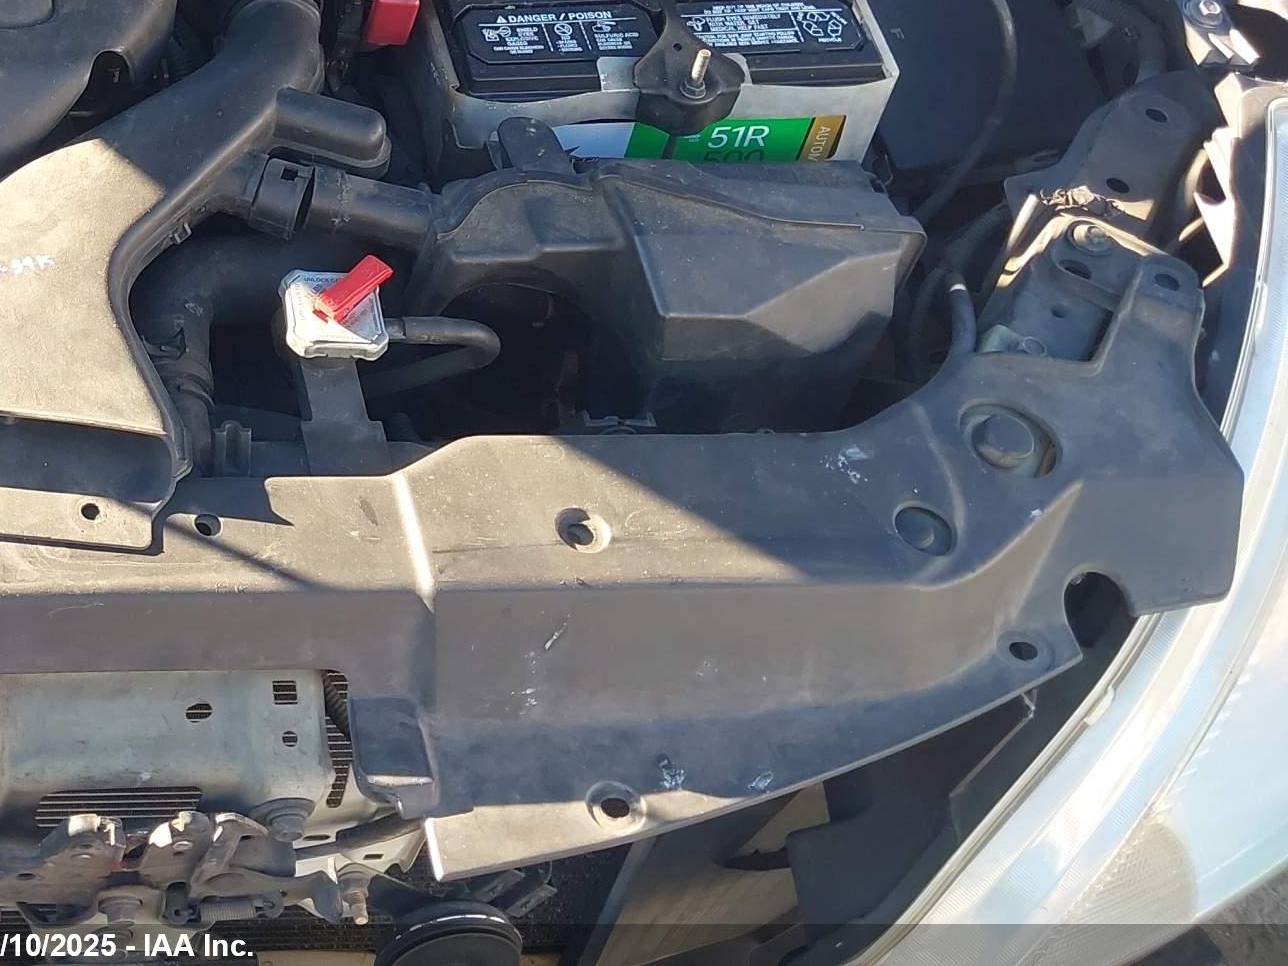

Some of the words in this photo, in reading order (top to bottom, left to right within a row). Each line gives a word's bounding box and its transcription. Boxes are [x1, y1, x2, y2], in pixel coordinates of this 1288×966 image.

[508, 13, 558, 23] DANGER
[568, 11, 613, 20] POISON
[708, 125, 770, 149] 51R
